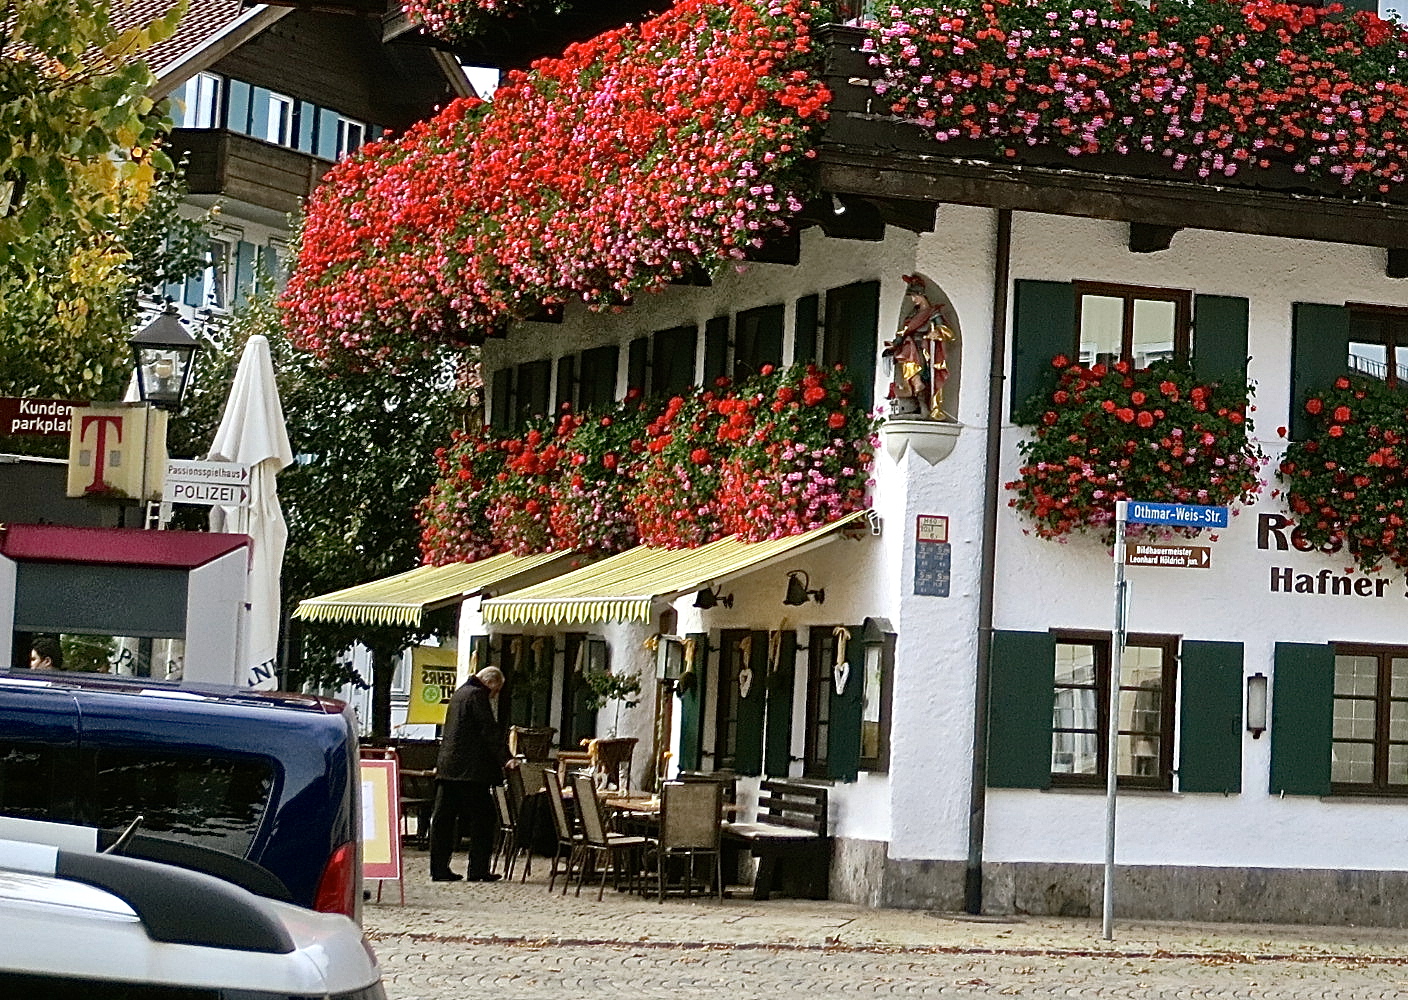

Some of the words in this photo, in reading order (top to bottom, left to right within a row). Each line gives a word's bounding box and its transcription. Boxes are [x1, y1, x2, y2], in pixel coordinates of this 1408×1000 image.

[19, 400, 72, 416] Kunden
[80, 416, 123, 492] T
[168, 464, 240, 479] Passionsspielhaus
[174, 484, 234, 502] POLIZEI
[1134, 504, 1222, 523] Othmar-Weis-Str.
[1129, 554, 1158, 564] Leonhard
[1136, 545, 1192, 557] Bildhauermeister
[1270, 565, 1389, 598] Hafner
